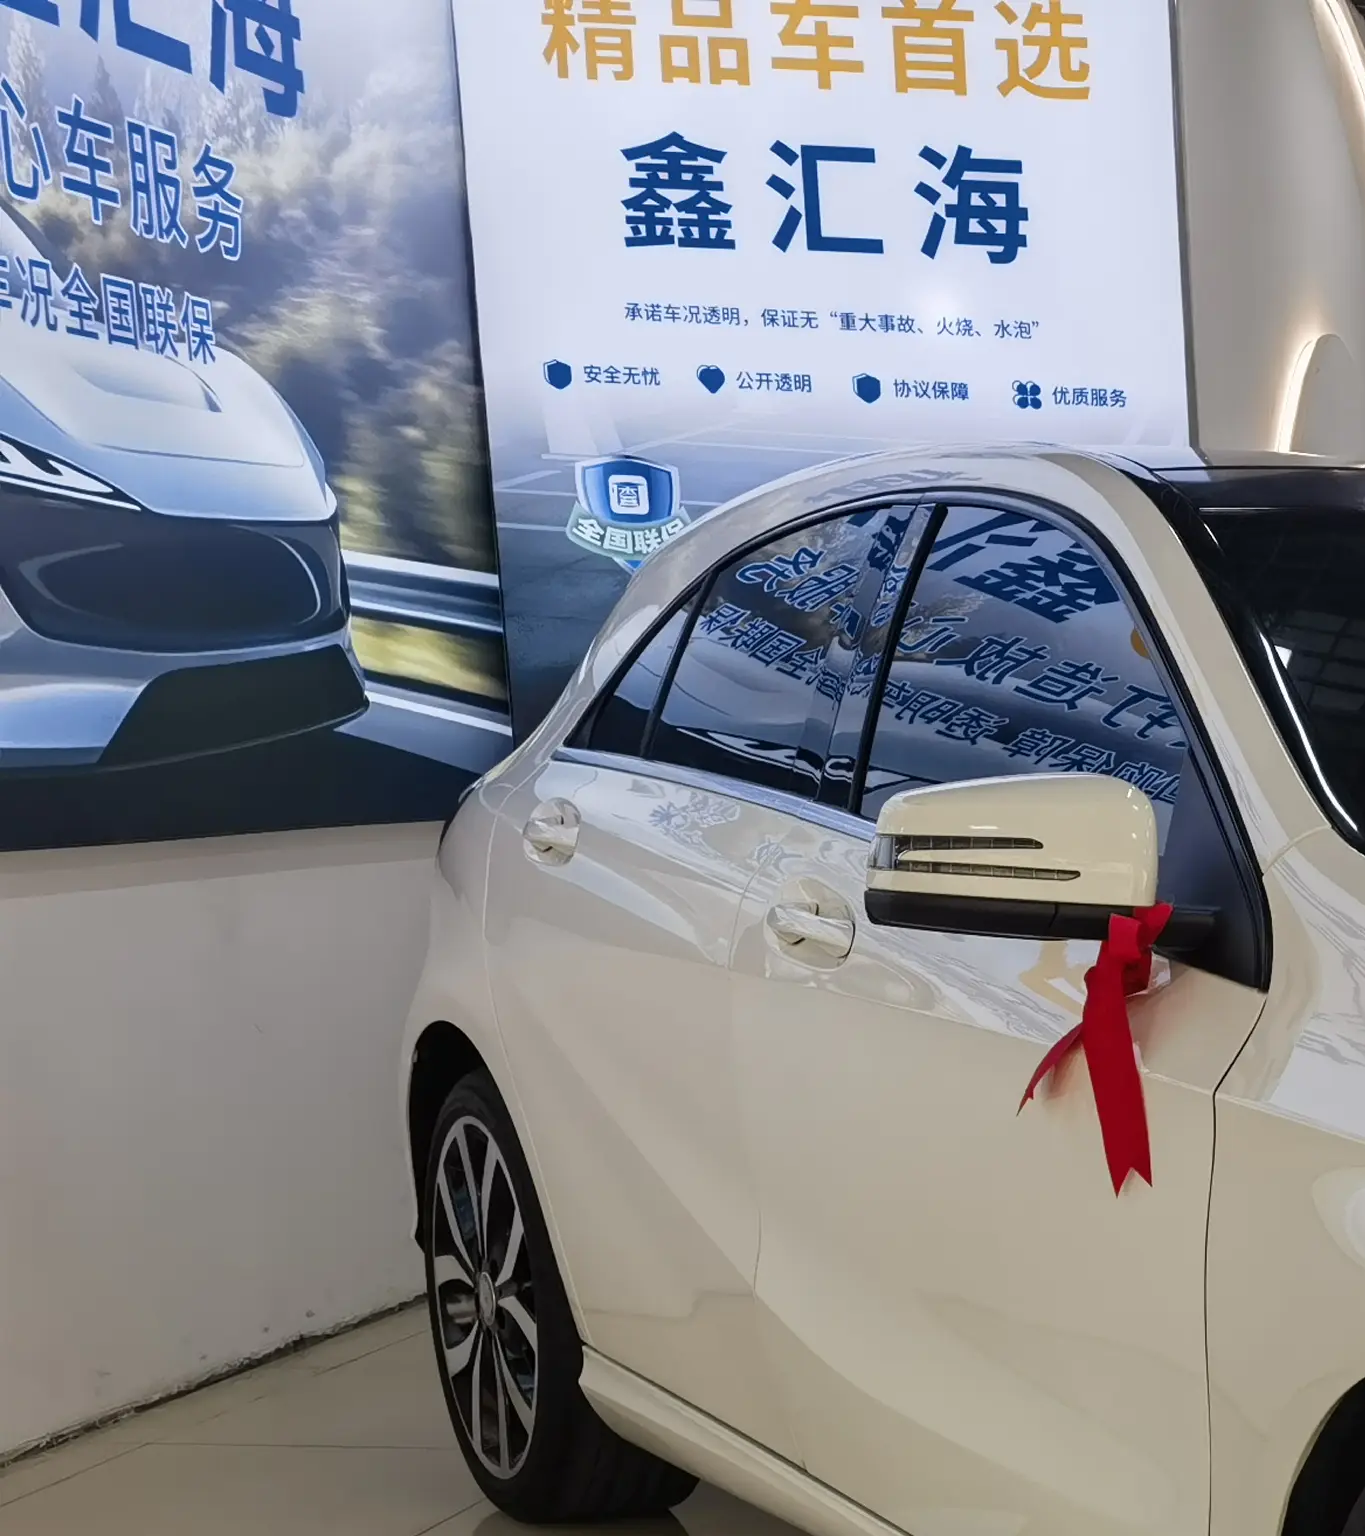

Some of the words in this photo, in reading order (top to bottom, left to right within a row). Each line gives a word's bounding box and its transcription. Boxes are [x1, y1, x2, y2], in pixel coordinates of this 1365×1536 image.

[541, 0, 1092, 100] 精品车首选
[620, 131, 1029, 264] 鑫汇海
[583, 365, 661, 387] 安全无忧
[736, 371, 812, 393] 公开透明
[893, 378, 970, 401] 协议保障
[1052, 386, 1127, 408] 优质服务
